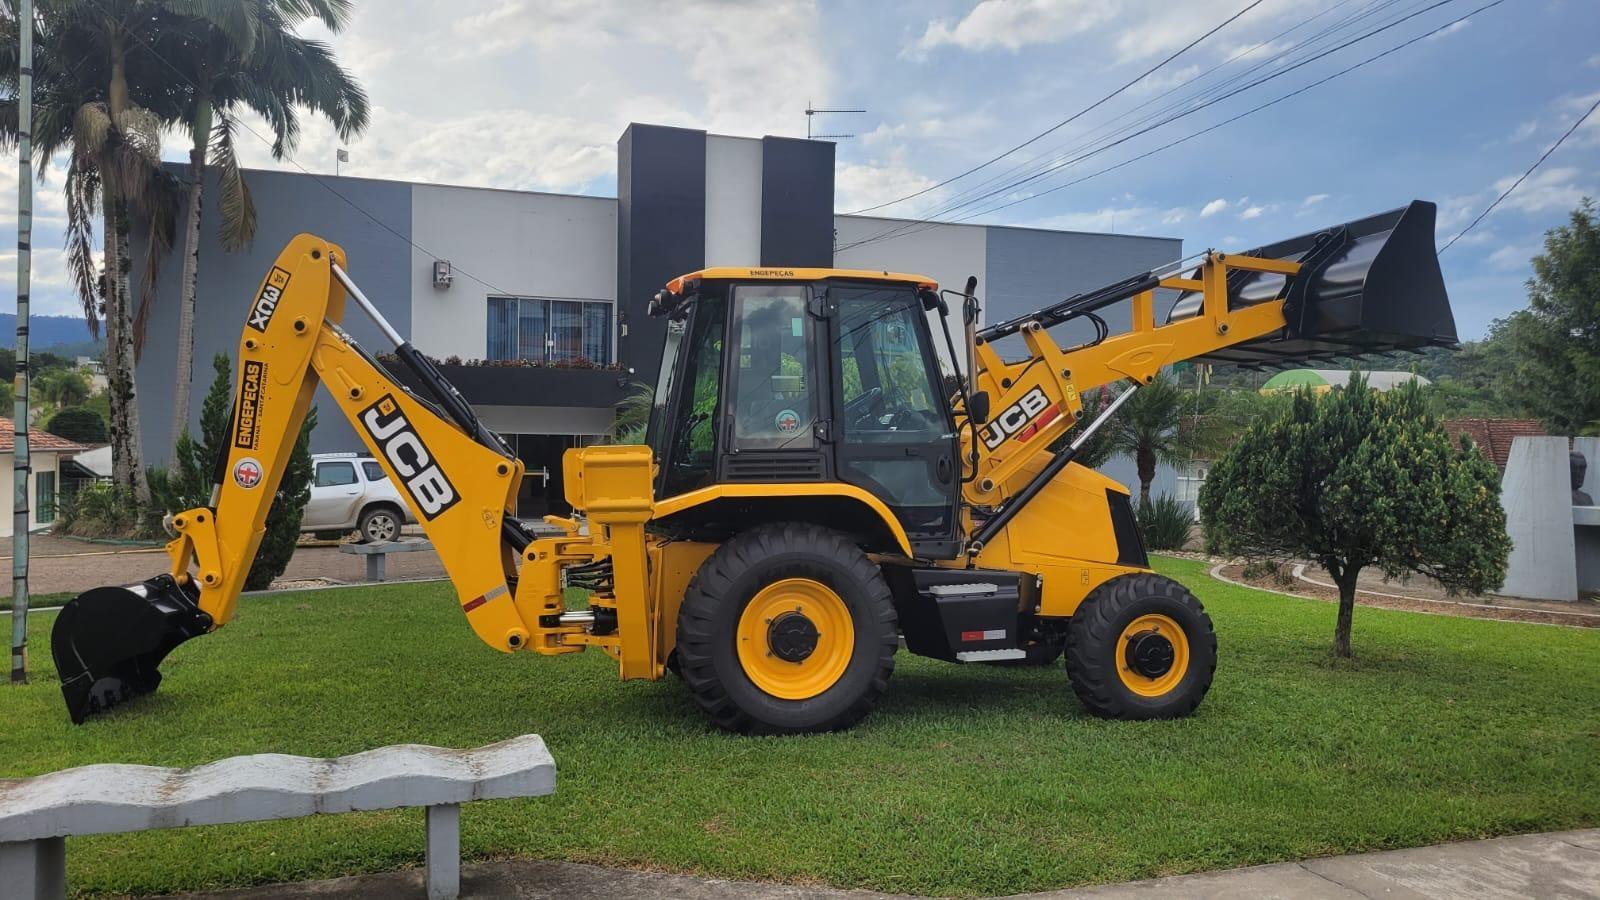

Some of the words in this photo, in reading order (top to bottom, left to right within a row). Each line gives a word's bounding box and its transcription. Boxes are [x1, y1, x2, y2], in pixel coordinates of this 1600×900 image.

[249, 285, 281, 330] 3CX
[986, 389, 1048, 448] JCB
[364, 408, 453, 514] JCB
